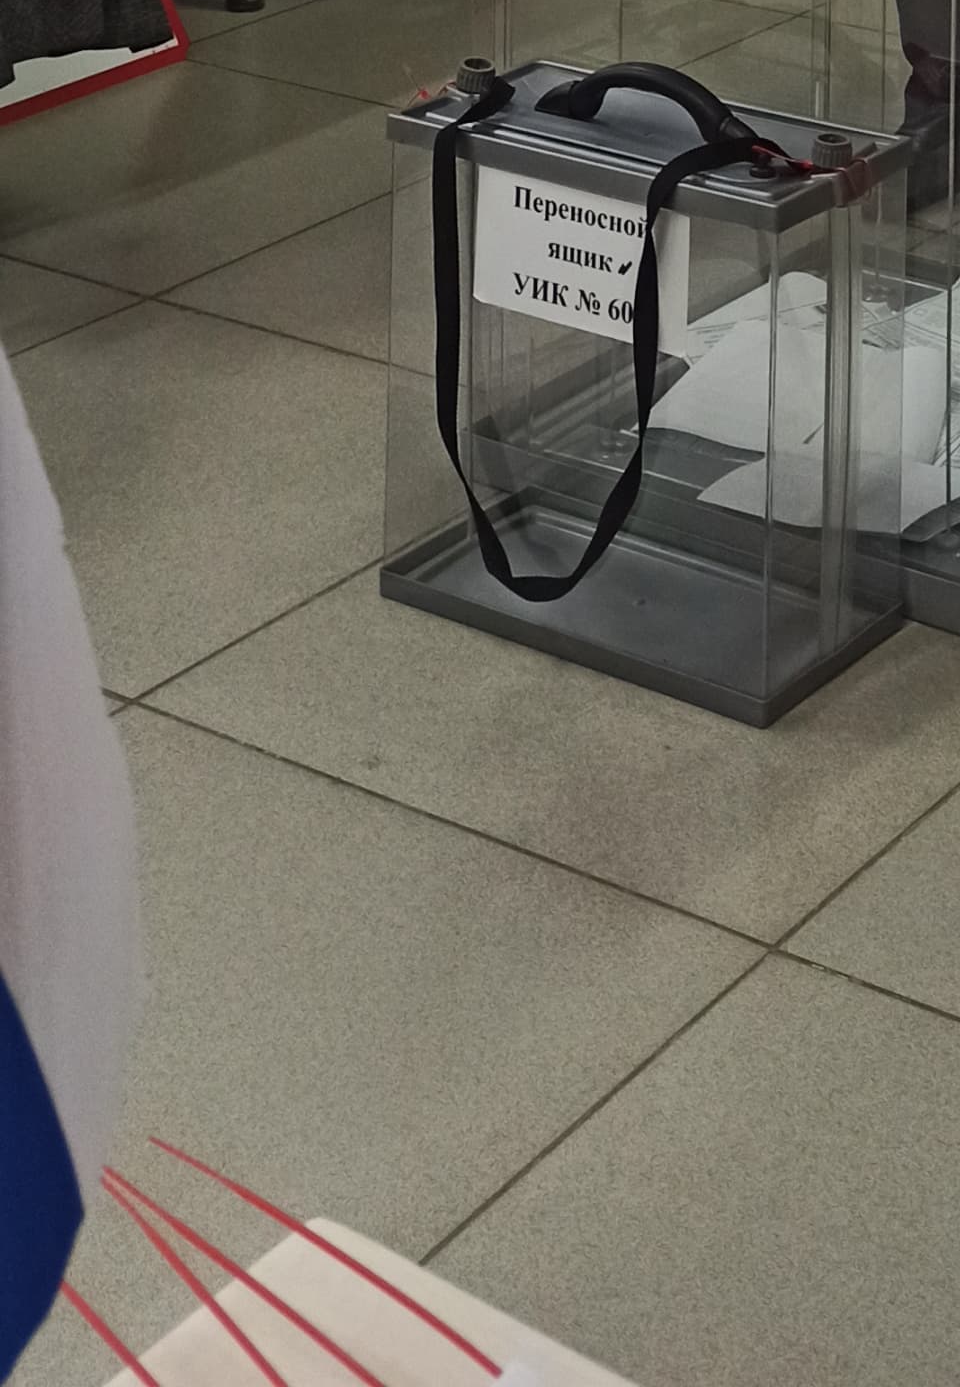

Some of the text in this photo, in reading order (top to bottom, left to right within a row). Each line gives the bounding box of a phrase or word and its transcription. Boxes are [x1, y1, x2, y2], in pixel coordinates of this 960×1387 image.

[514, 185, 648, 239] Переносной
[548, 242, 613, 273] ящик
[513, 272, 569, 308] УИК
[575, 289, 601, 315] №
